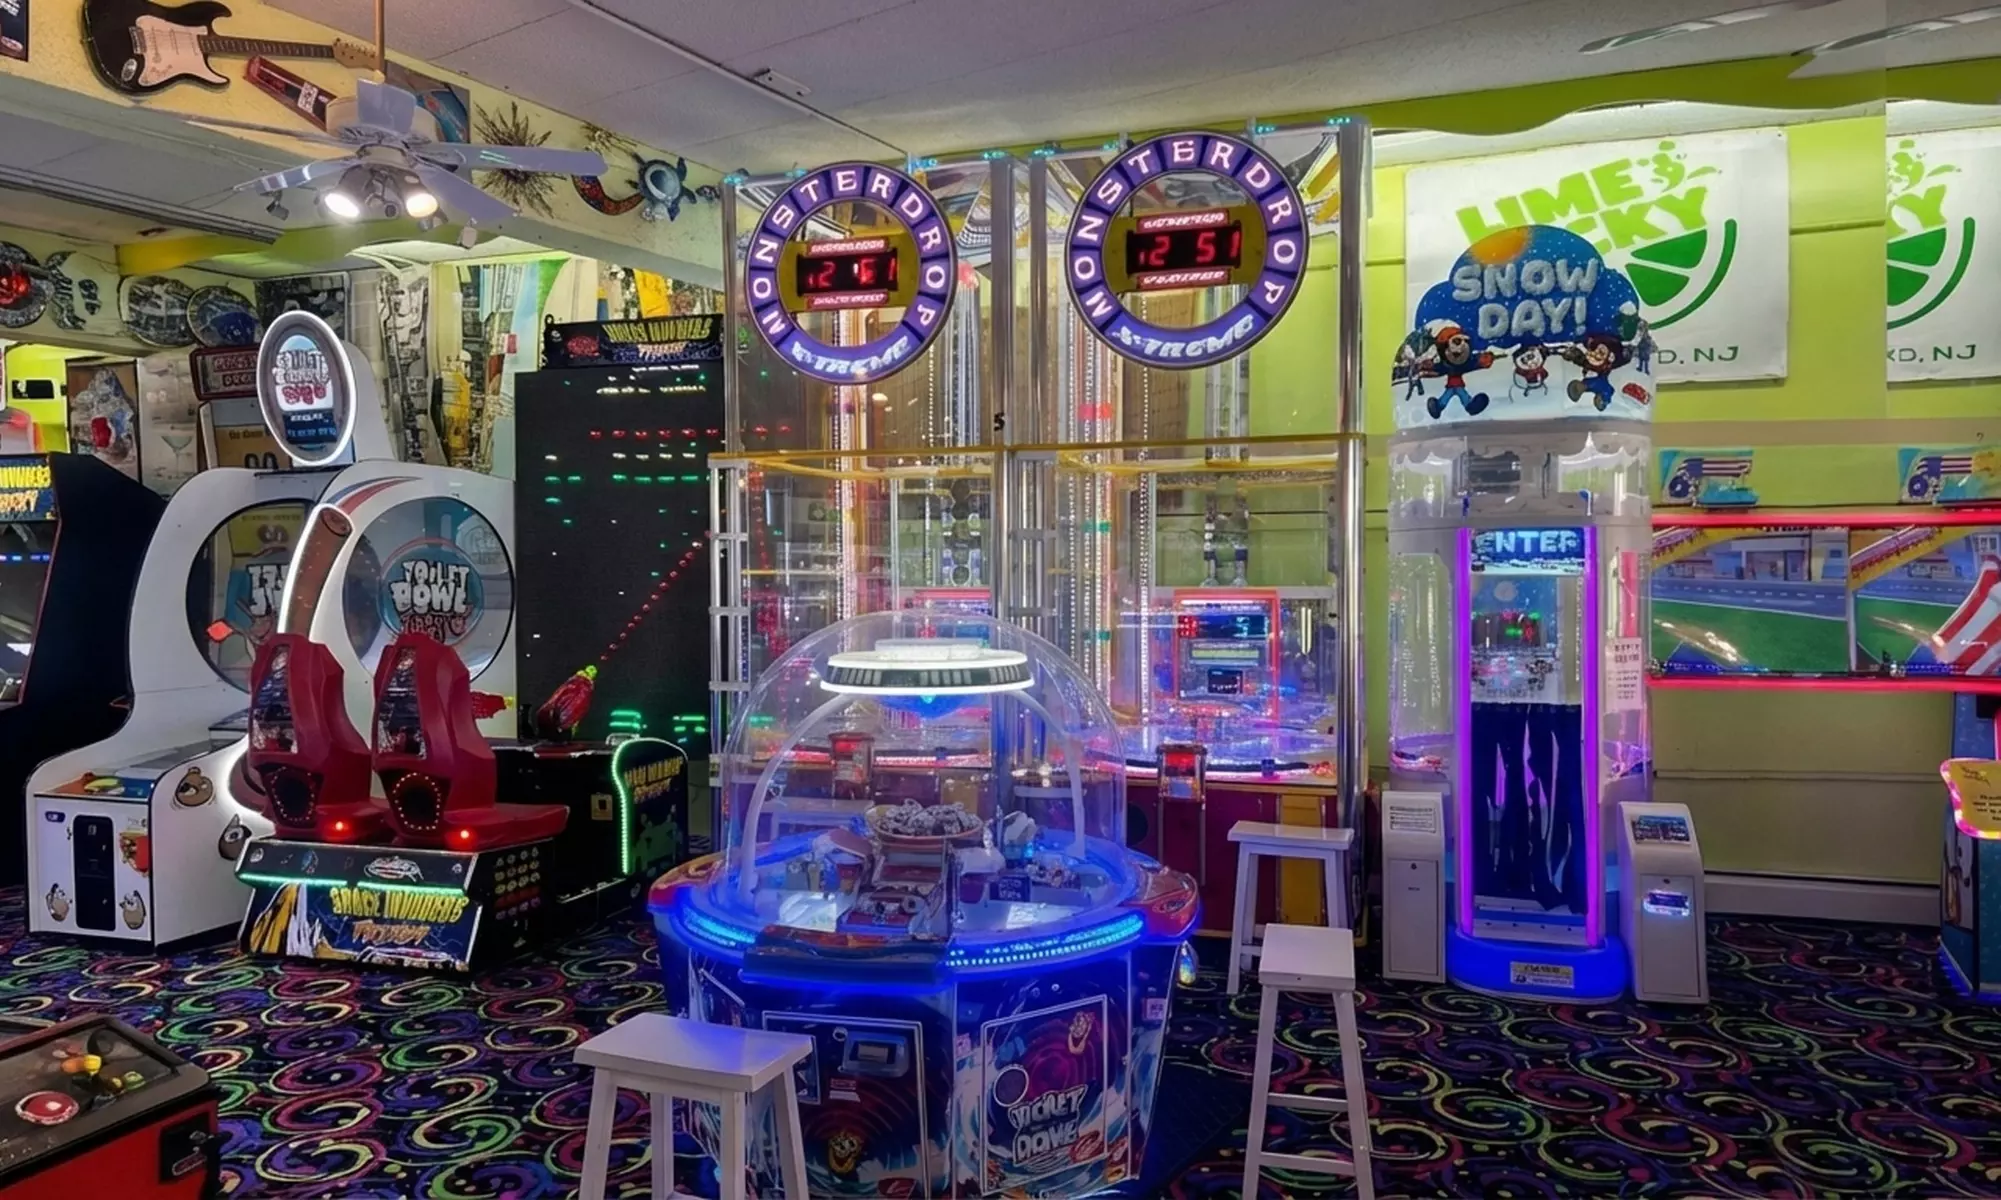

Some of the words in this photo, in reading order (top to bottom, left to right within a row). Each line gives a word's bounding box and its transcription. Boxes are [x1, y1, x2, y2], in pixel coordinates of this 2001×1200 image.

[1452, 258, 1598, 302] SNOW
[1478, 297, 1587, 340] DAY!
[1693, 345, 1740, 363] NJ
[1932, 344, 1977, 362] NJ
